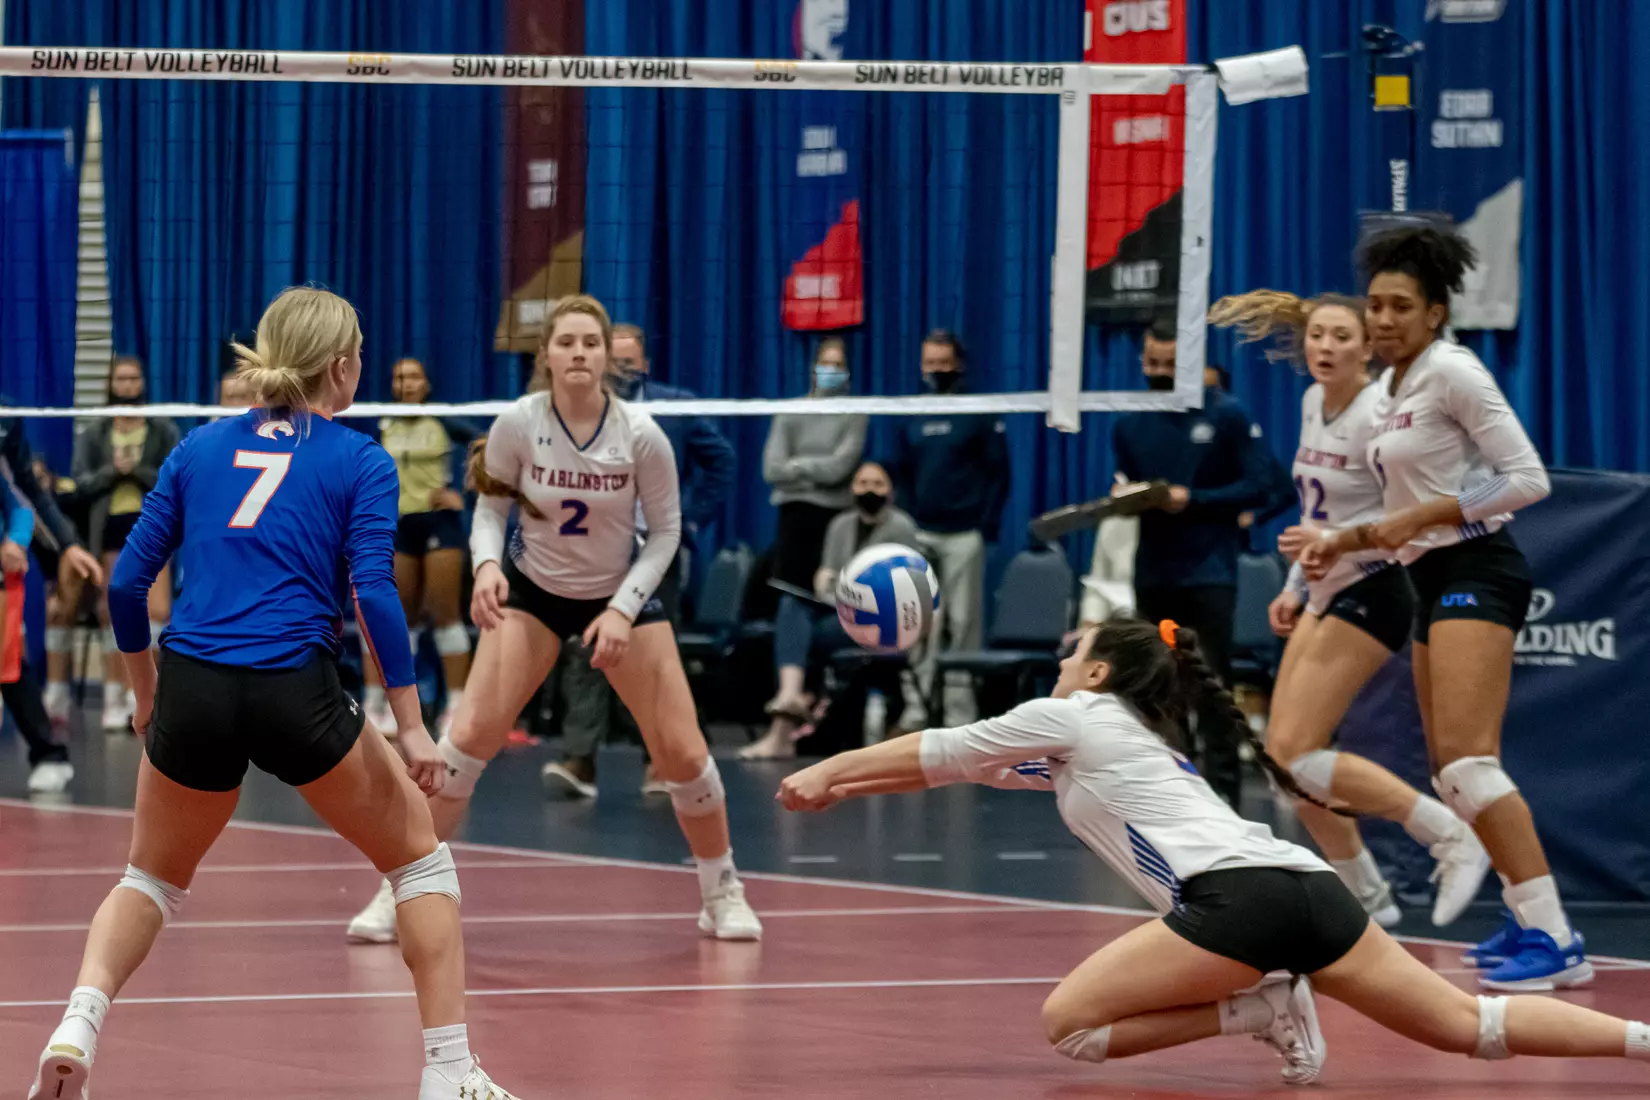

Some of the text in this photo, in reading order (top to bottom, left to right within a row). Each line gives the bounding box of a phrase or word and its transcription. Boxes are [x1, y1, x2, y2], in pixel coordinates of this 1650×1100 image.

[31, 50, 78, 71] SUN
[84, 52, 137, 72] BELT
[144, 52, 284, 74] VOLLEYBALL
[452, 58, 497, 78] SUN
[502, 59, 551, 79] BELT
[560, 60, 693, 80] VOLLEYBALL
[855, 64, 897, 84] SUN
[903, 65, 950, 85] BELT
[959, 67, 1064, 87] VOLLEYBA
[228, 449, 293, 529] 7
[1294, 474, 1328, 520] 12
[559, 499, 589, 535] 2
[1441, 593, 1479, 607] UTA
